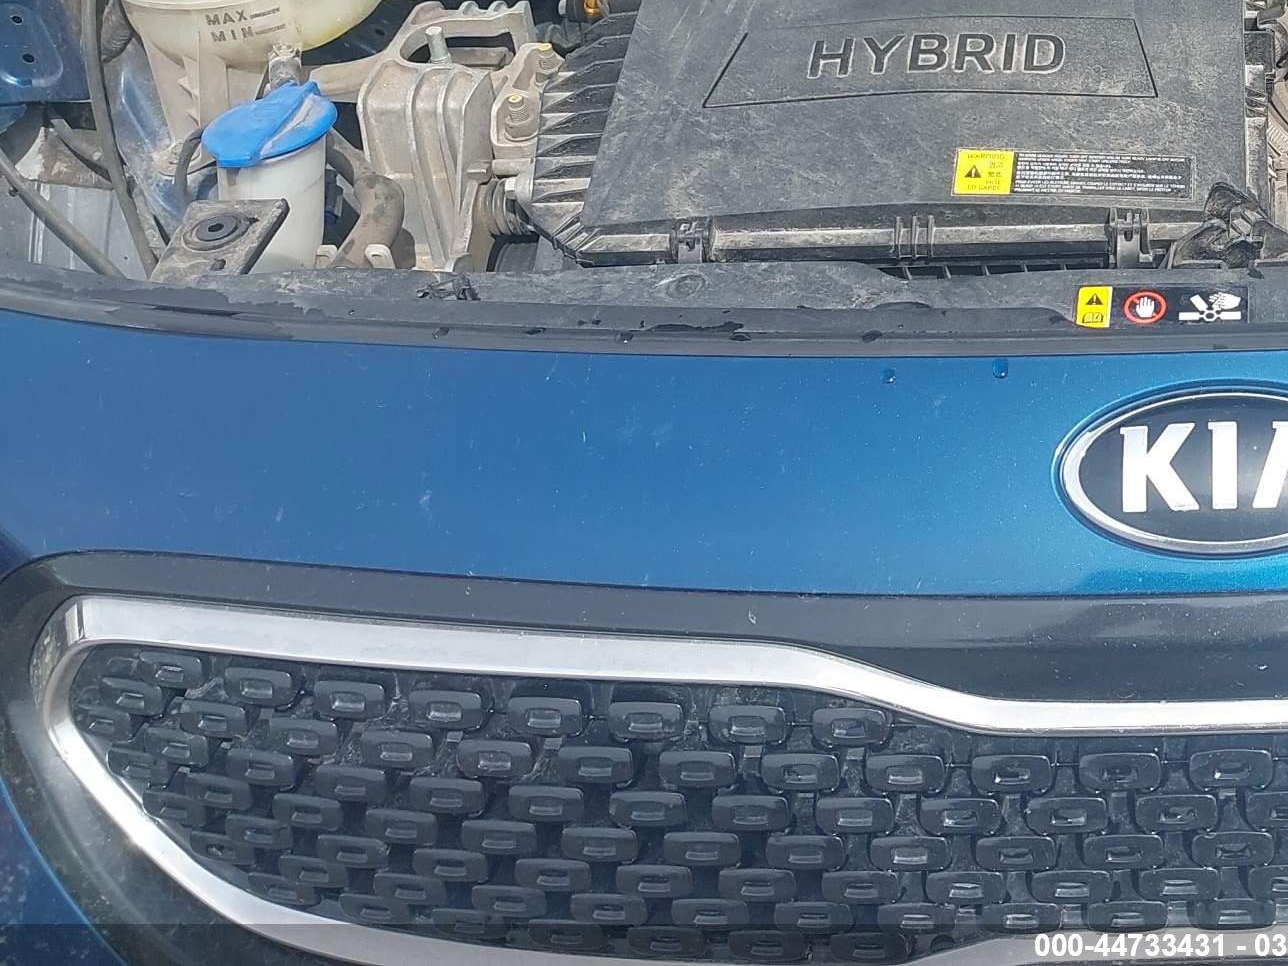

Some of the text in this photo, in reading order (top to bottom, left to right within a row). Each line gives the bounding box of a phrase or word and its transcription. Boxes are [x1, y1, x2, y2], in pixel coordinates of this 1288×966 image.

[205, 10, 247, 26] MAX
[211, 26, 255, 42] MIN
[807, 32, 1065, 79] HYBRID
